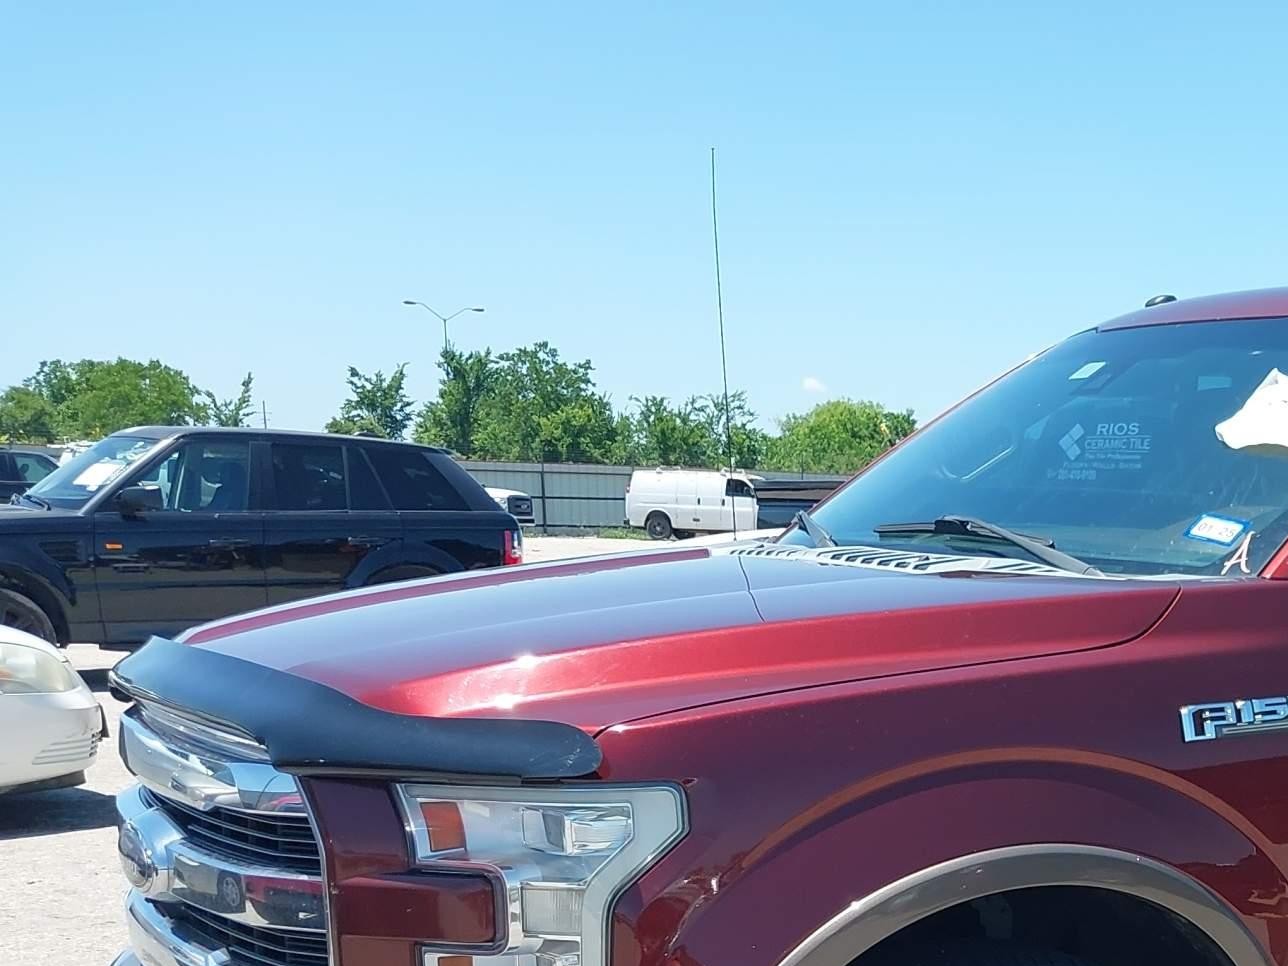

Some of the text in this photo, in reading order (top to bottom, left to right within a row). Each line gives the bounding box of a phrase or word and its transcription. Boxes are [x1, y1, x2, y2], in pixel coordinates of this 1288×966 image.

[1096, 423, 1140, 435] RIOS
[1084, 438, 1151, 450] CERAMIC TILE
